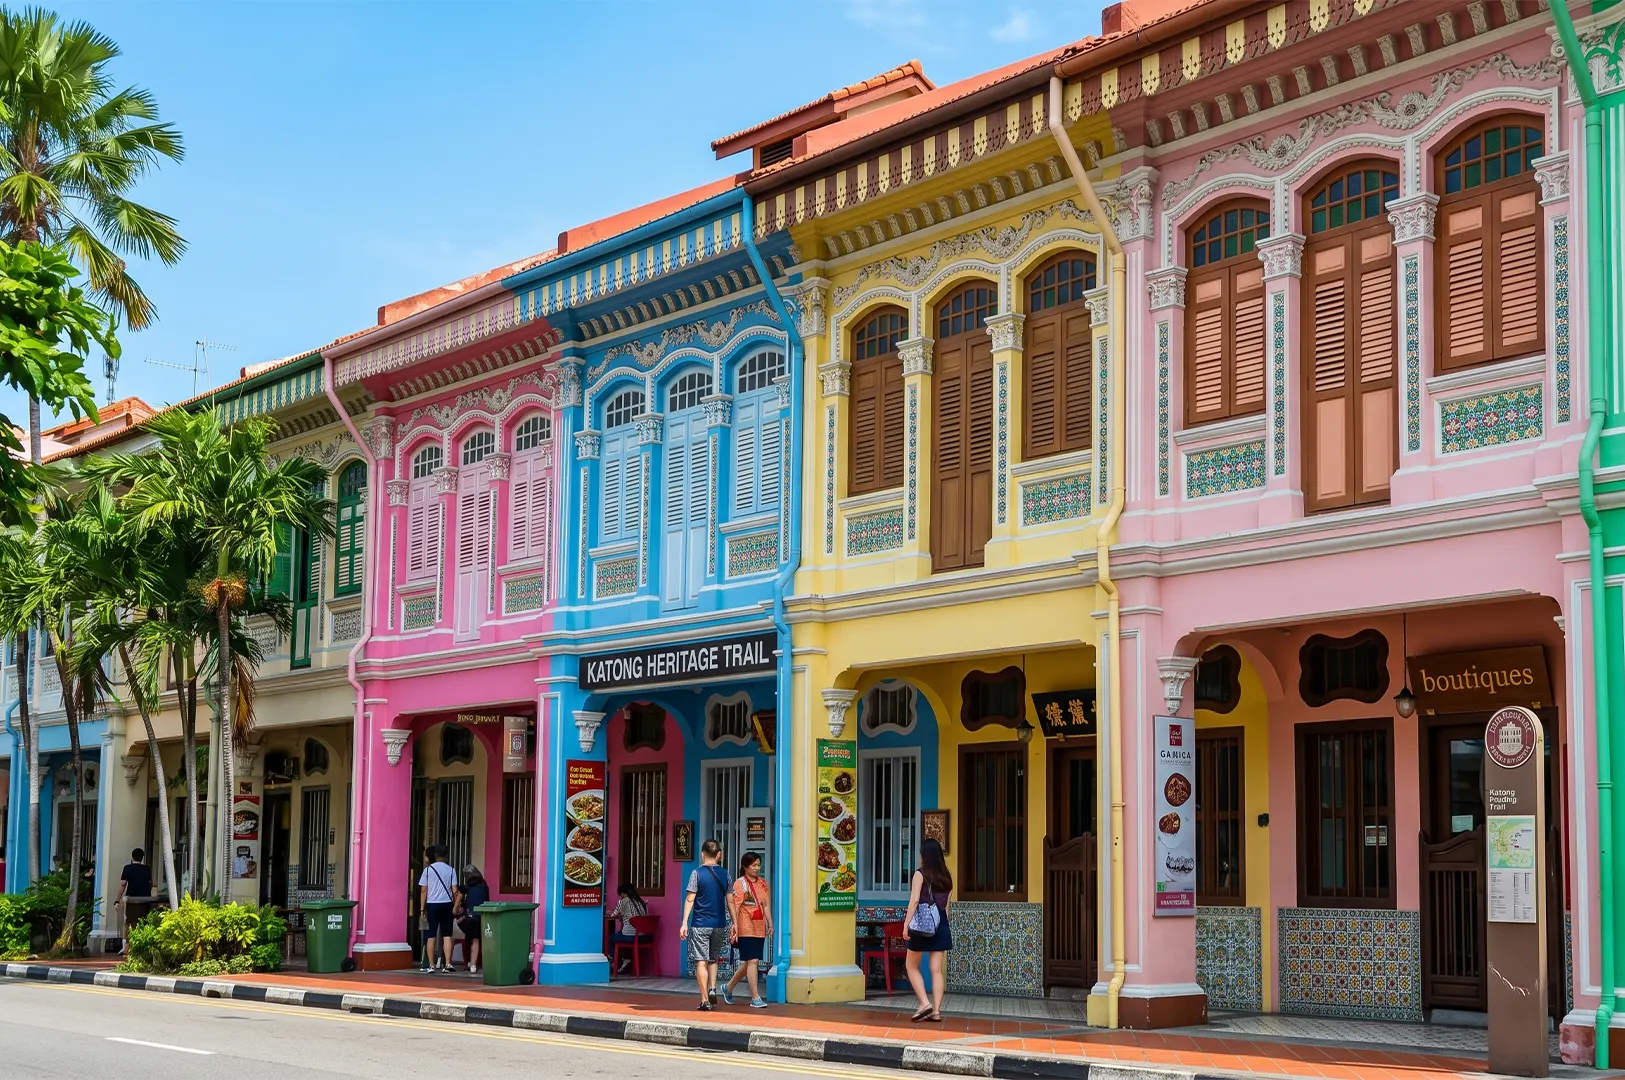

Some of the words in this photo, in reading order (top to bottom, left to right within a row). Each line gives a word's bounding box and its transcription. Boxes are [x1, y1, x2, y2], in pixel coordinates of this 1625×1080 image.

[587, 656, 642, 683] KATONG
[647, 647, 718, 677] HERITAGE
[722, 641, 770, 668] TRAIL
[1420, 664, 1534, 694] boutiques
[1489, 789, 1515, 797] Katong
